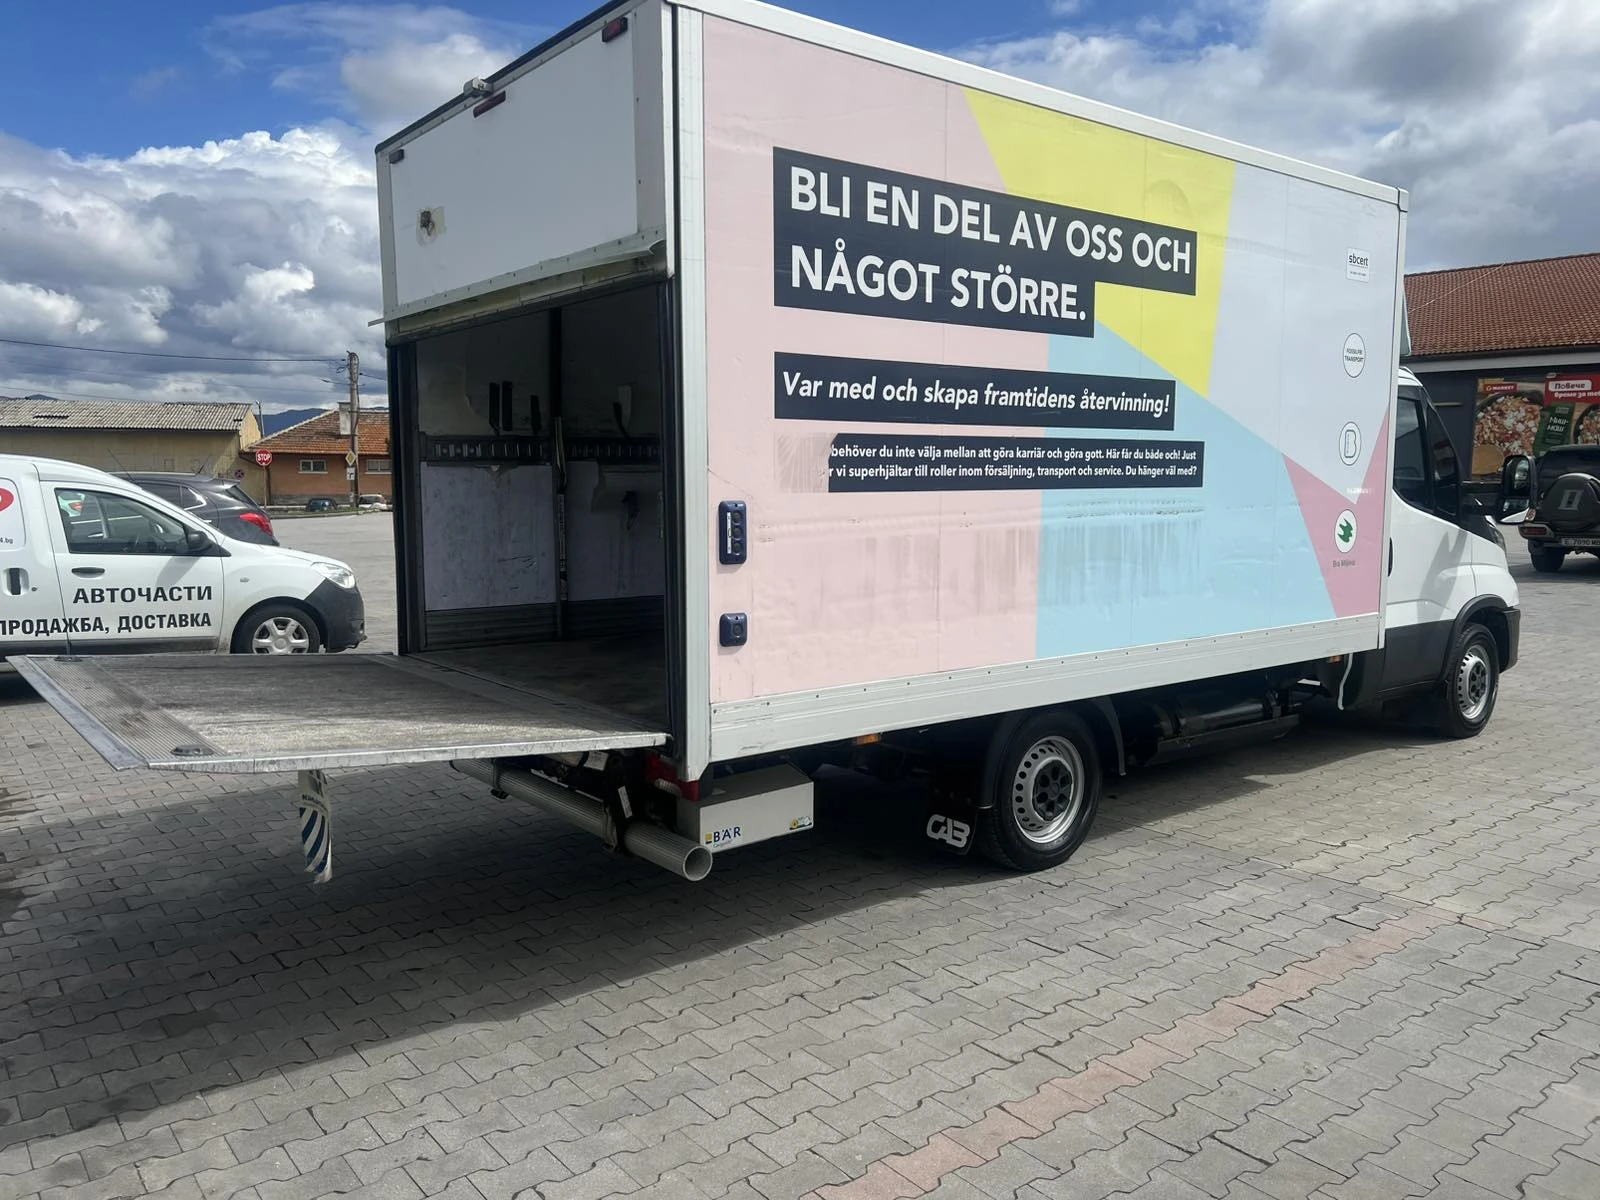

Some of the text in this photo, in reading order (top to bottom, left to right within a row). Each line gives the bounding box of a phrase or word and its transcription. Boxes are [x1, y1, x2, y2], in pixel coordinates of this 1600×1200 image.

[790, 166, 1191, 274] BLI EN DEL AV OSS OCH
[1348, 252, 1369, 267] sbcert
[790, 237, 1087, 321] NÅGOT STÖRRE.
[783, 371, 1170, 418] Var med och skapa framtidens återvinning!
[1554, 382, 1586, 390] Повече
[257, 453, 271, 461] STOP
[831, 444, 877, 457] behöver
[879, 445, 893, 457] du
[895, 446, 916, 458] inte
[917, 446, 942, 461] välja
[943, 446, 976, 458] mellan
[978, 447, 991, 458] att
[993, 447, 1014, 461] göra
[1016, 447, 1045, 459] karriär
[1047, 448, 1062, 459] och
[1064, 448, 1083, 461] göra
[1085, 449, 1104, 461] gott.
[1106, 449, 1120, 459] Här
[1133, 449, 1144, 459] du
[1145, 449, 1164, 460] både
[1164, 450, 1180, 460] och!
[1181, 450, 1196, 460] Just
[836, 465, 846, 477] vi
[848, 464, 912, 480] superhjältar
[914, 465, 928, 477] till
[930, 465, 958, 477] roller
[958, 465, 982, 477] inom
[984, 464, 1035, 479] försäljning,
[1037, 466, 1076, 478] transport
[1077, 465, 1093, 476] och
[1094, 466, 1124, 476] service.
[1125, 465, 1136, 475] Du
[1138, 465, 1164, 478] hänger
[1165, 465, 1176, 476] väl
[1177, 466, 1197, 476] med?
[72, 585, 213, 604] АВТОЧАСТИ
[117, 612, 212, 634] ДОСТАВКА
[713, 826, 741, 843] BÄR
